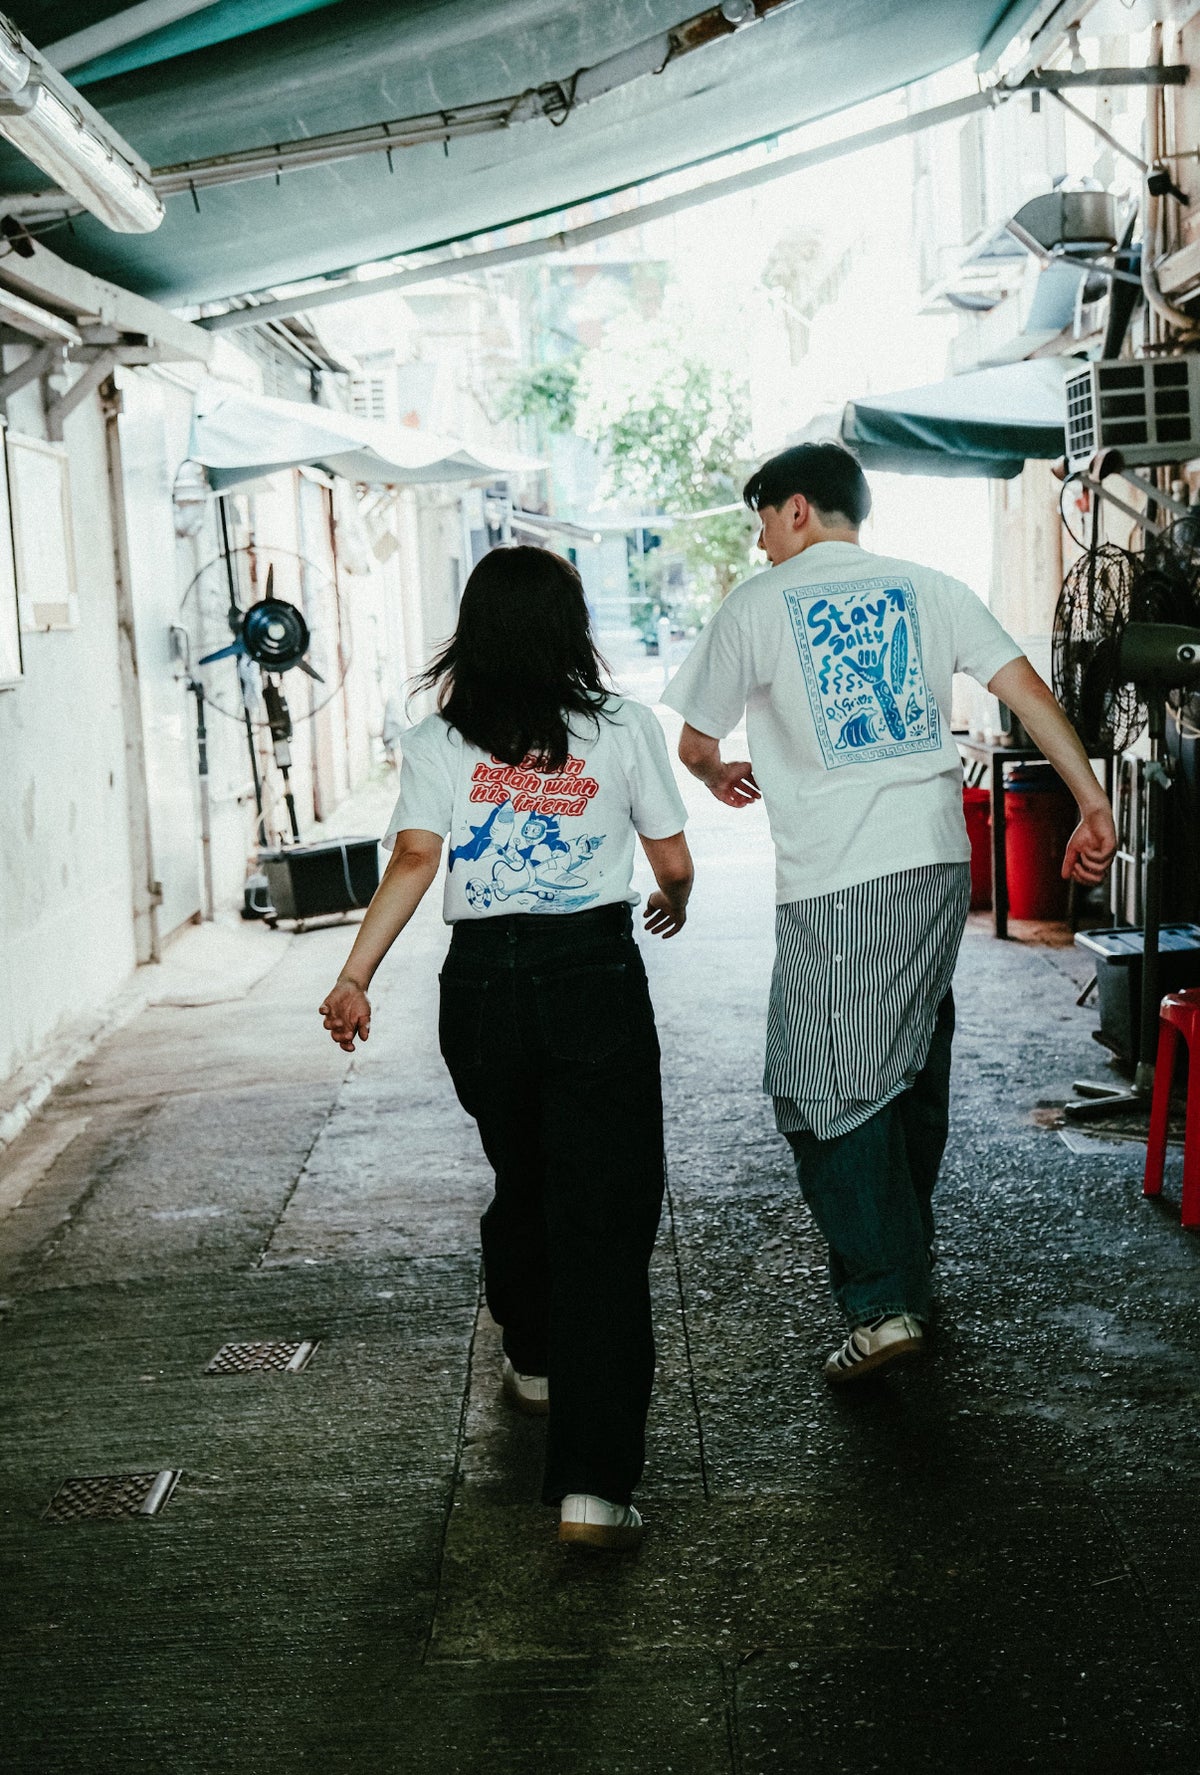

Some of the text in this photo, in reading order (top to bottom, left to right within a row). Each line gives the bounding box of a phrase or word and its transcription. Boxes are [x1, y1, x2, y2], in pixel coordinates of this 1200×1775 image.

[807, 599, 887, 647] Stay
[470, 782, 588, 816] his friend
[542, 776, 599, 798] with
